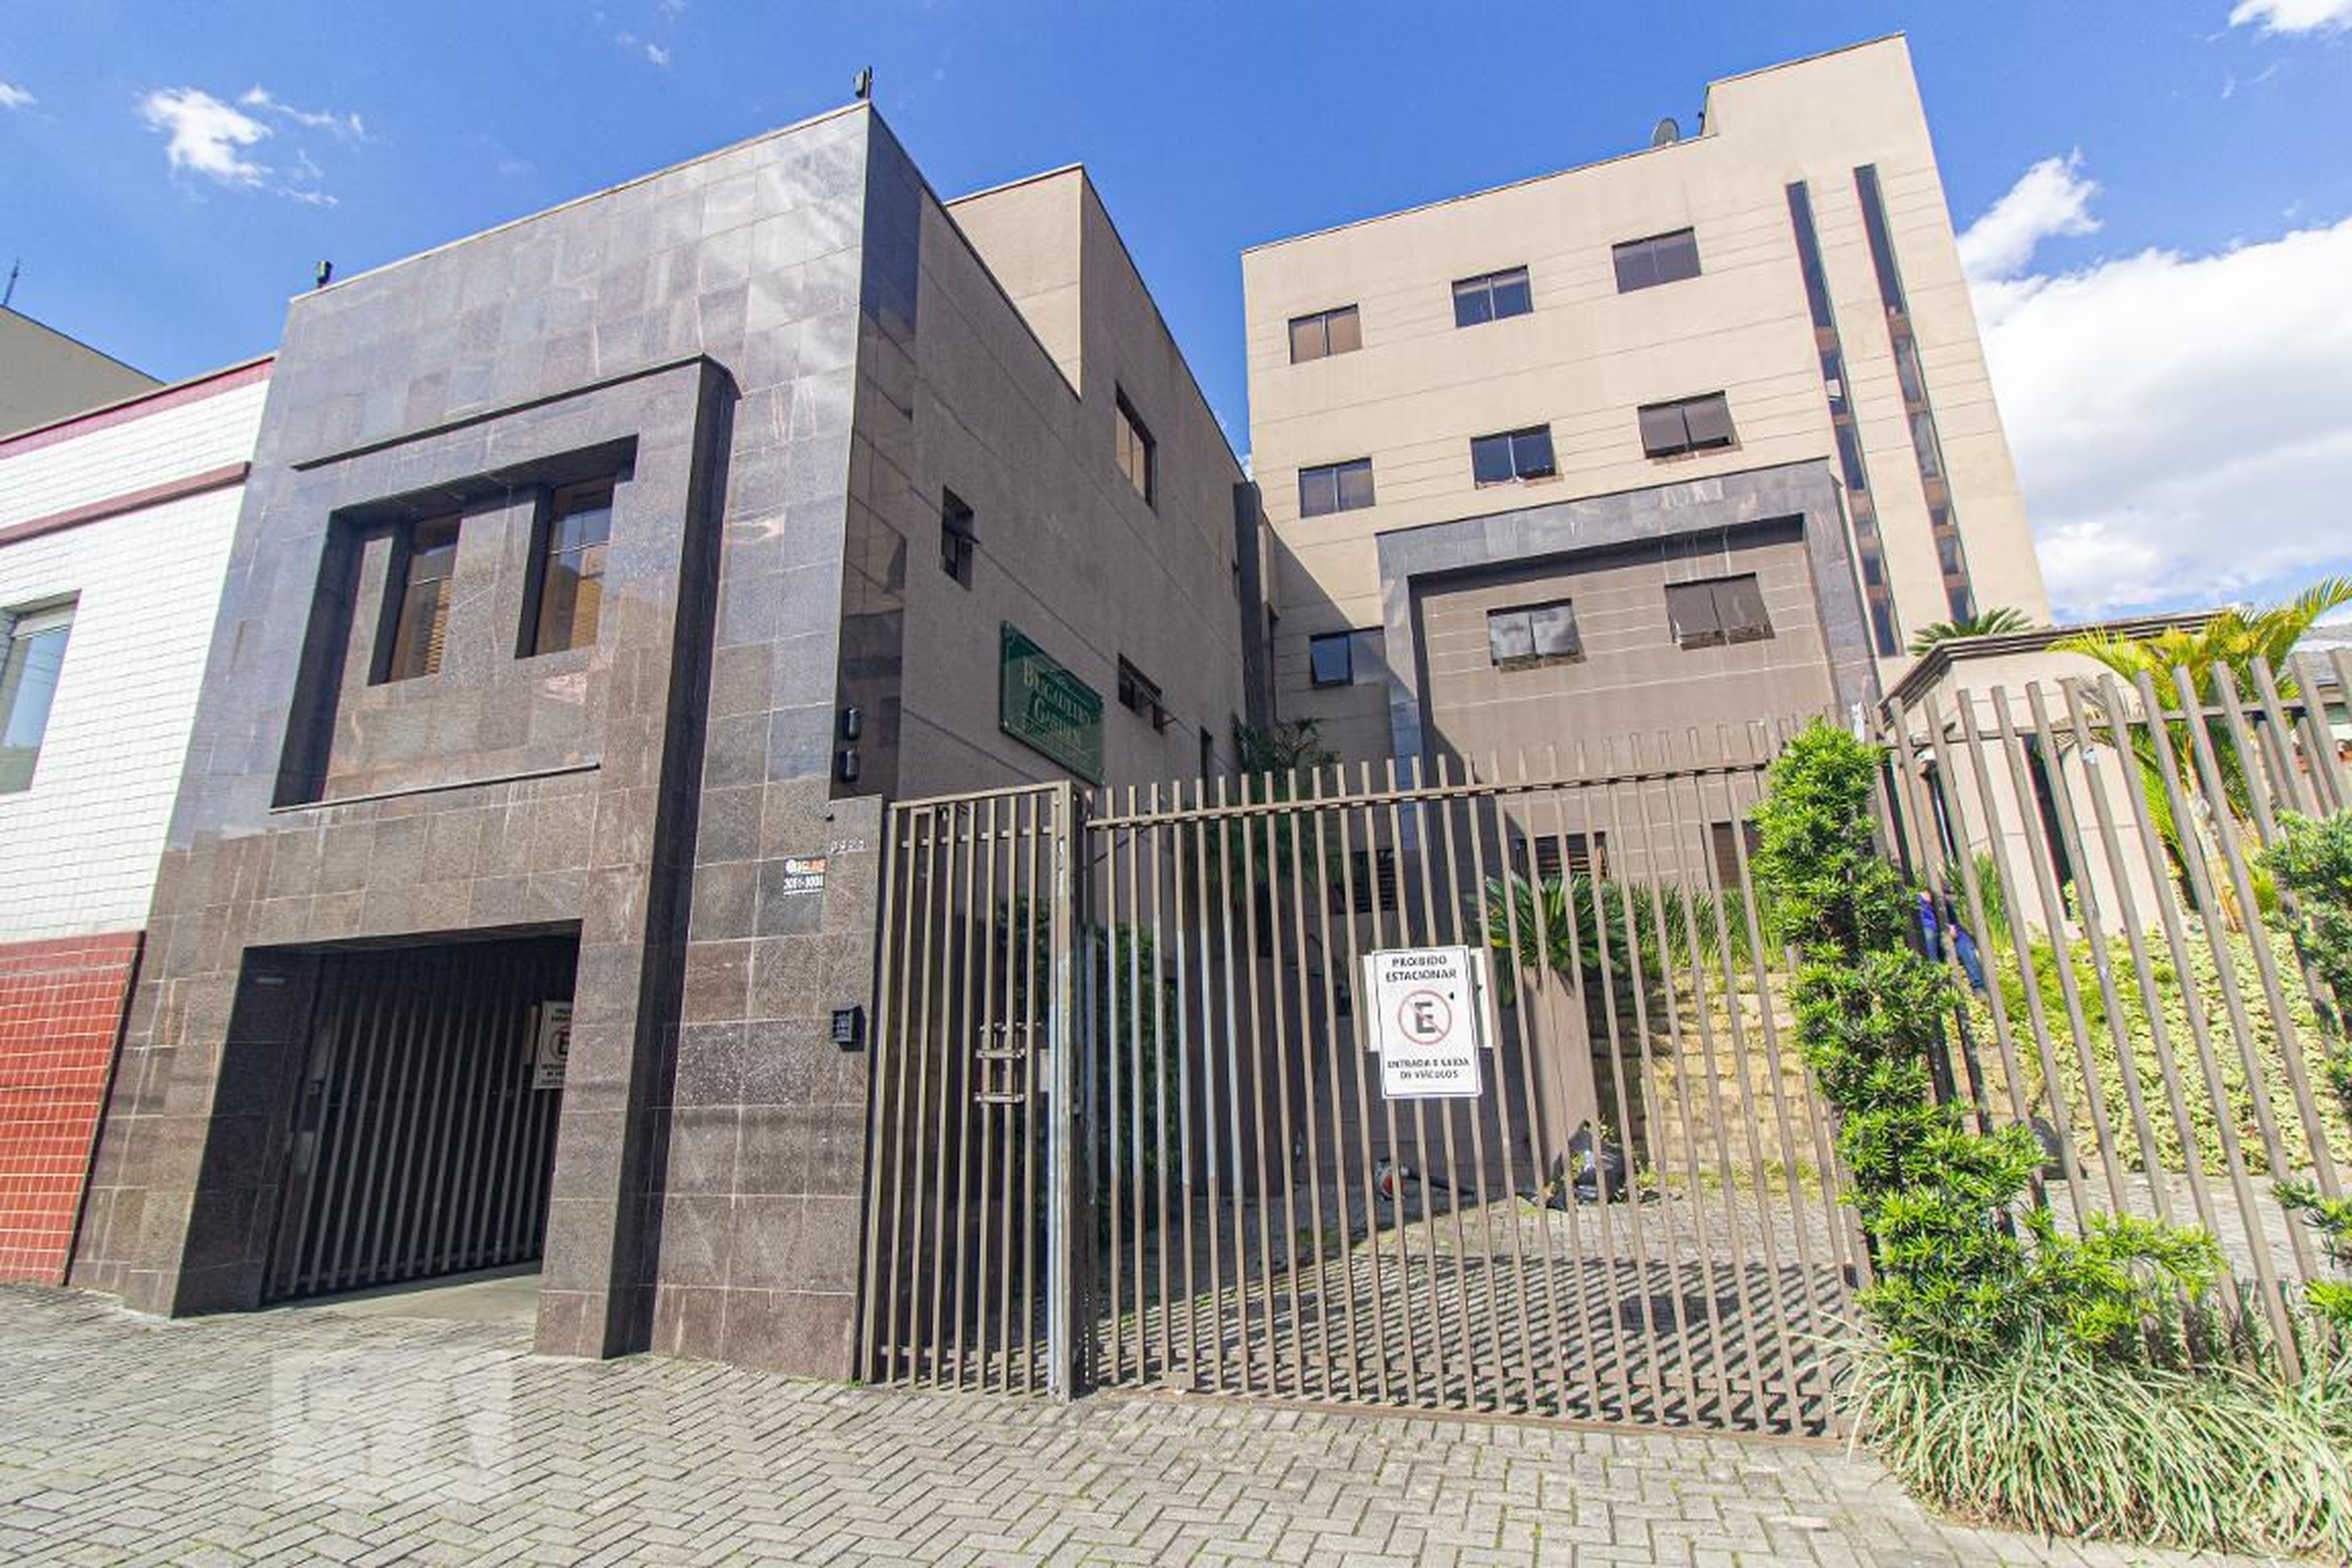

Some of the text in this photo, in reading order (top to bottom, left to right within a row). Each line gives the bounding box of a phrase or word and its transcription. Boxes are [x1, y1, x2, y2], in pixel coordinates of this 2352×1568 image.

[1392, 956, 1447, 967] PROIBIDO
[1385, 969, 1457, 982] ESTACIONAR
[1387, 1059, 1431, 1068] ENTRADA
